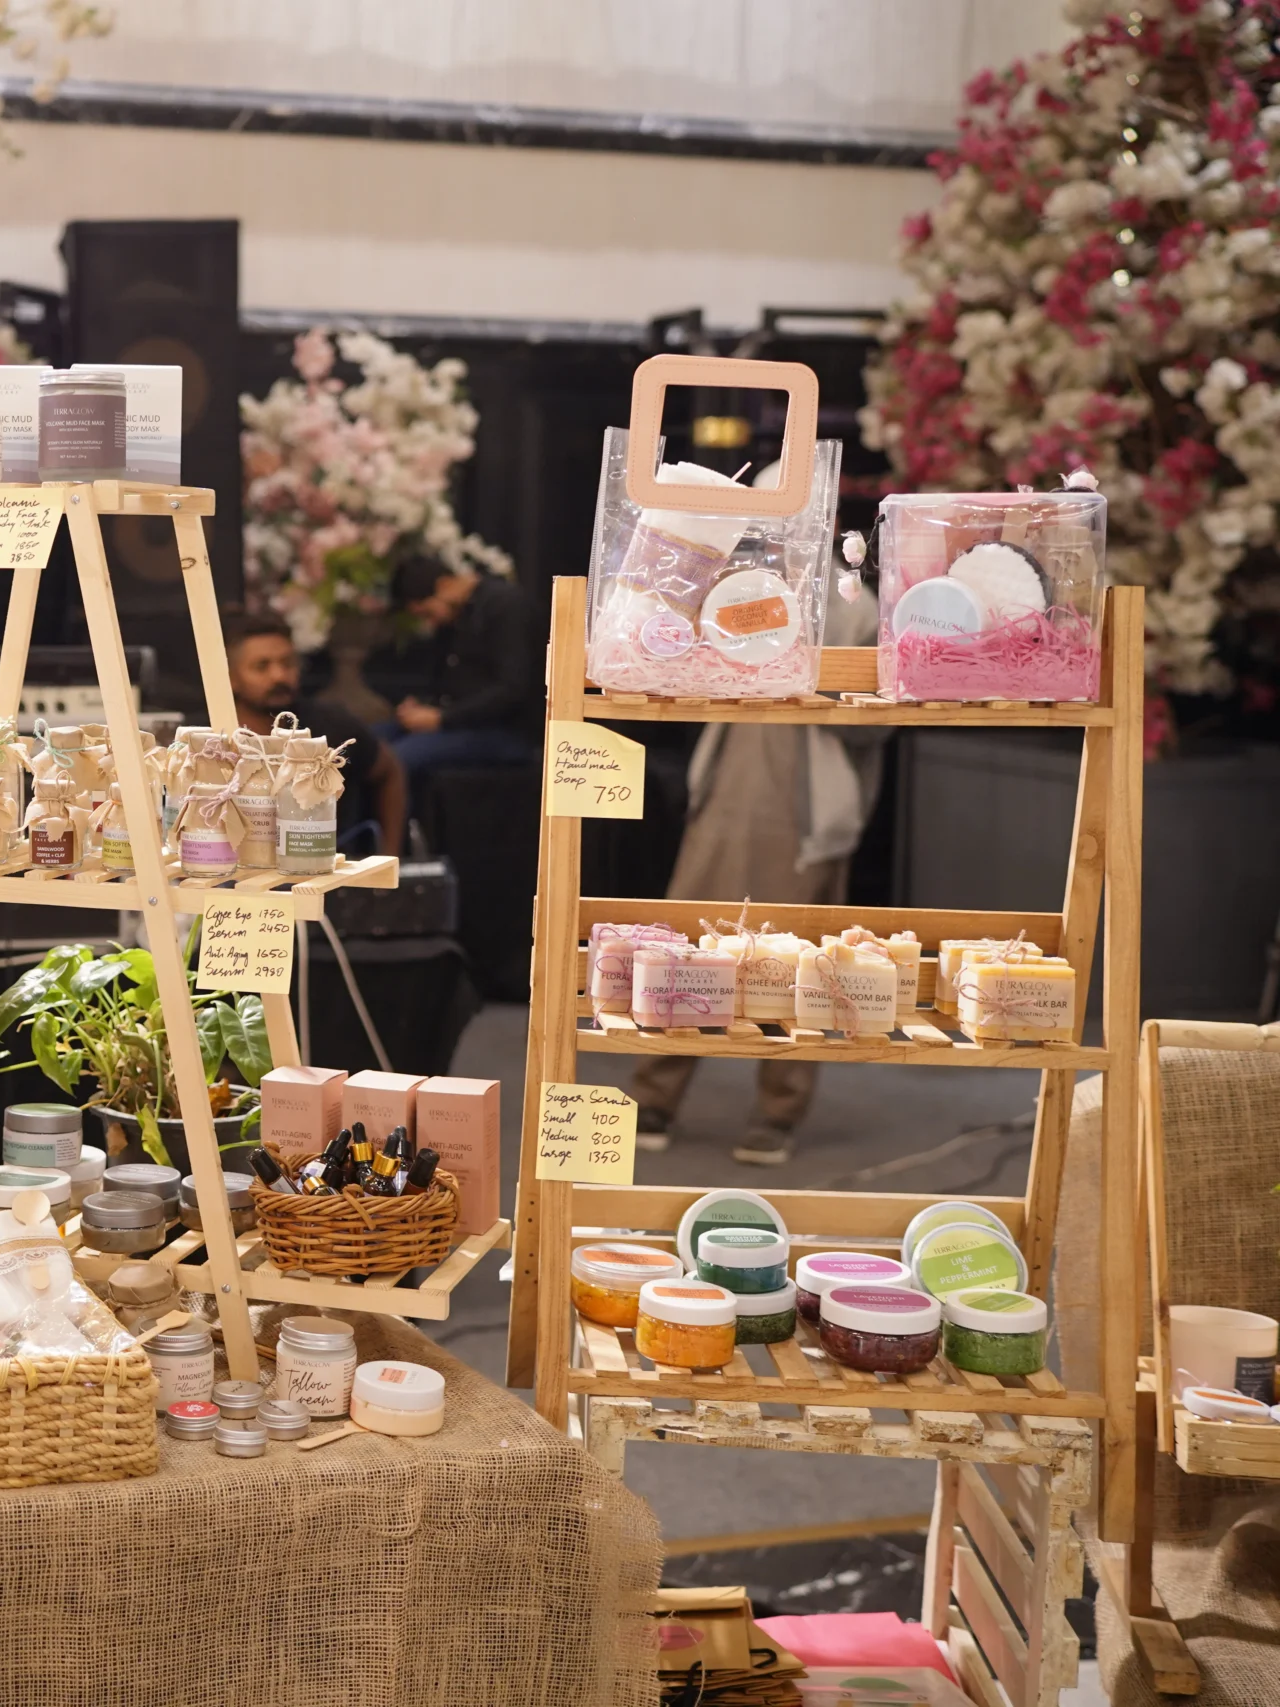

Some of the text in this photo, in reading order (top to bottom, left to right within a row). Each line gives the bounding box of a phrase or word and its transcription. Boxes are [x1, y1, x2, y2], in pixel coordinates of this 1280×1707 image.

[54, 408, 96, 416] TERRAGLOW
[12, 415, 33, 424] MUD
[138, 415, 161, 424] MUD
[16, 509, 38, 518] Face
[557, 740, 610, 762] Organic
[554, 770, 587, 791] Soap
[593, 785, 632, 804] 750
[206, 905, 285, 927] Coffee Eye 1750
[207, 922, 290, 941] Serum 2450
[204, 945, 227, 958] Anti
[257, 948, 288, 959] 1650
[255, 966, 285, 977] 2980
[747, 978, 769, 987] GHEE
[900, 979, 916, 987] BAR
[675, 987, 718, 995] HARMONY
[720, 987, 735, 995] BAR
[875, 994, 893, 1002] BAR
[1050, 1000, 1068, 1009] BAR
[546, 1085, 631, 1108] Sugar Scrub
[543, 1109, 620, 1125] Small 400
[271, 1129, 312, 1140] ANTI-AGING
[541, 1128, 622, 1145] Medium 800
[279, 1138, 304, 1149] SERUM
[427, 1141, 473, 1152] ANTI-AGING
[540, 1145, 621, 1167] Large 1350
[951, 1255, 975, 1267] LIME
[961, 1263, 970, 1272] &
[940, 1265, 999, 1285] PEPPERMINT
[285, 1369, 332, 1392] Tallow
